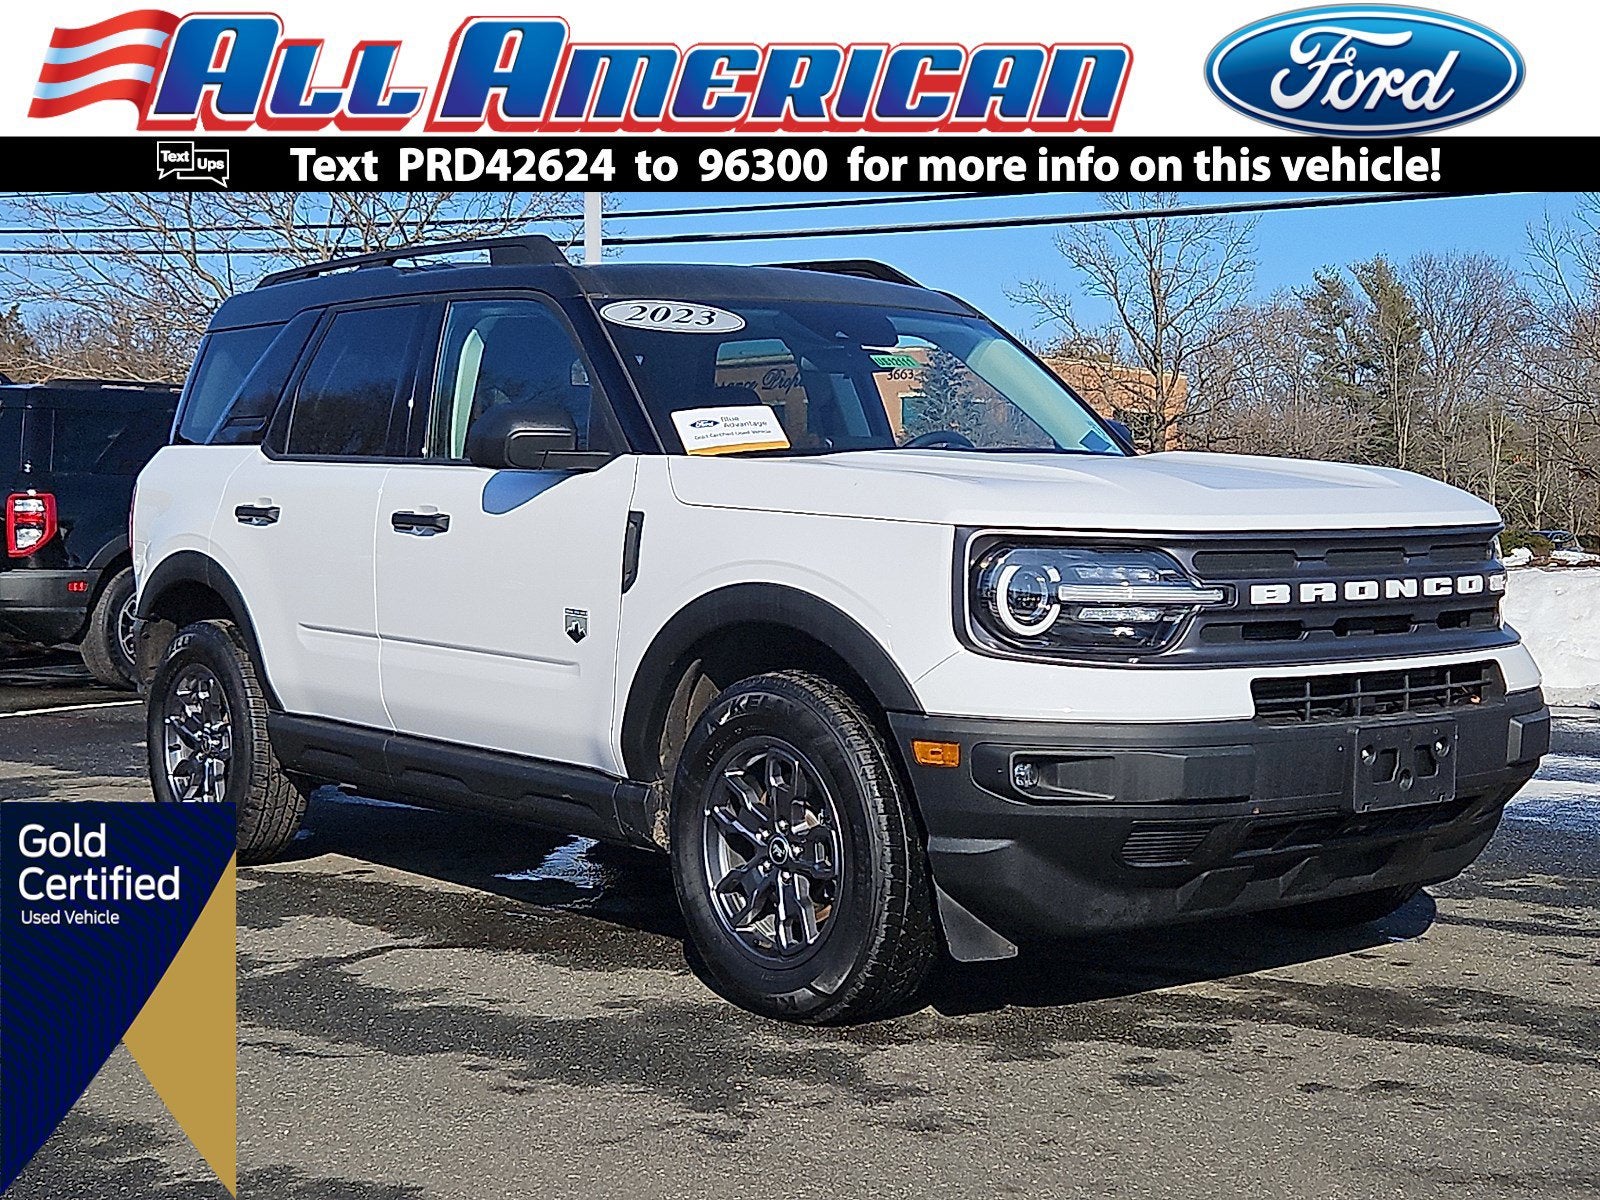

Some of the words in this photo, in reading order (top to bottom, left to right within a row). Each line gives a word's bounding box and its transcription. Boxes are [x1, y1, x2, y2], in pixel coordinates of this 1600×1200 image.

[624, 305, 717, 326] 2023
[886, 369, 914, 381] 3663
[1250, 575, 1484, 605] BRONCO
